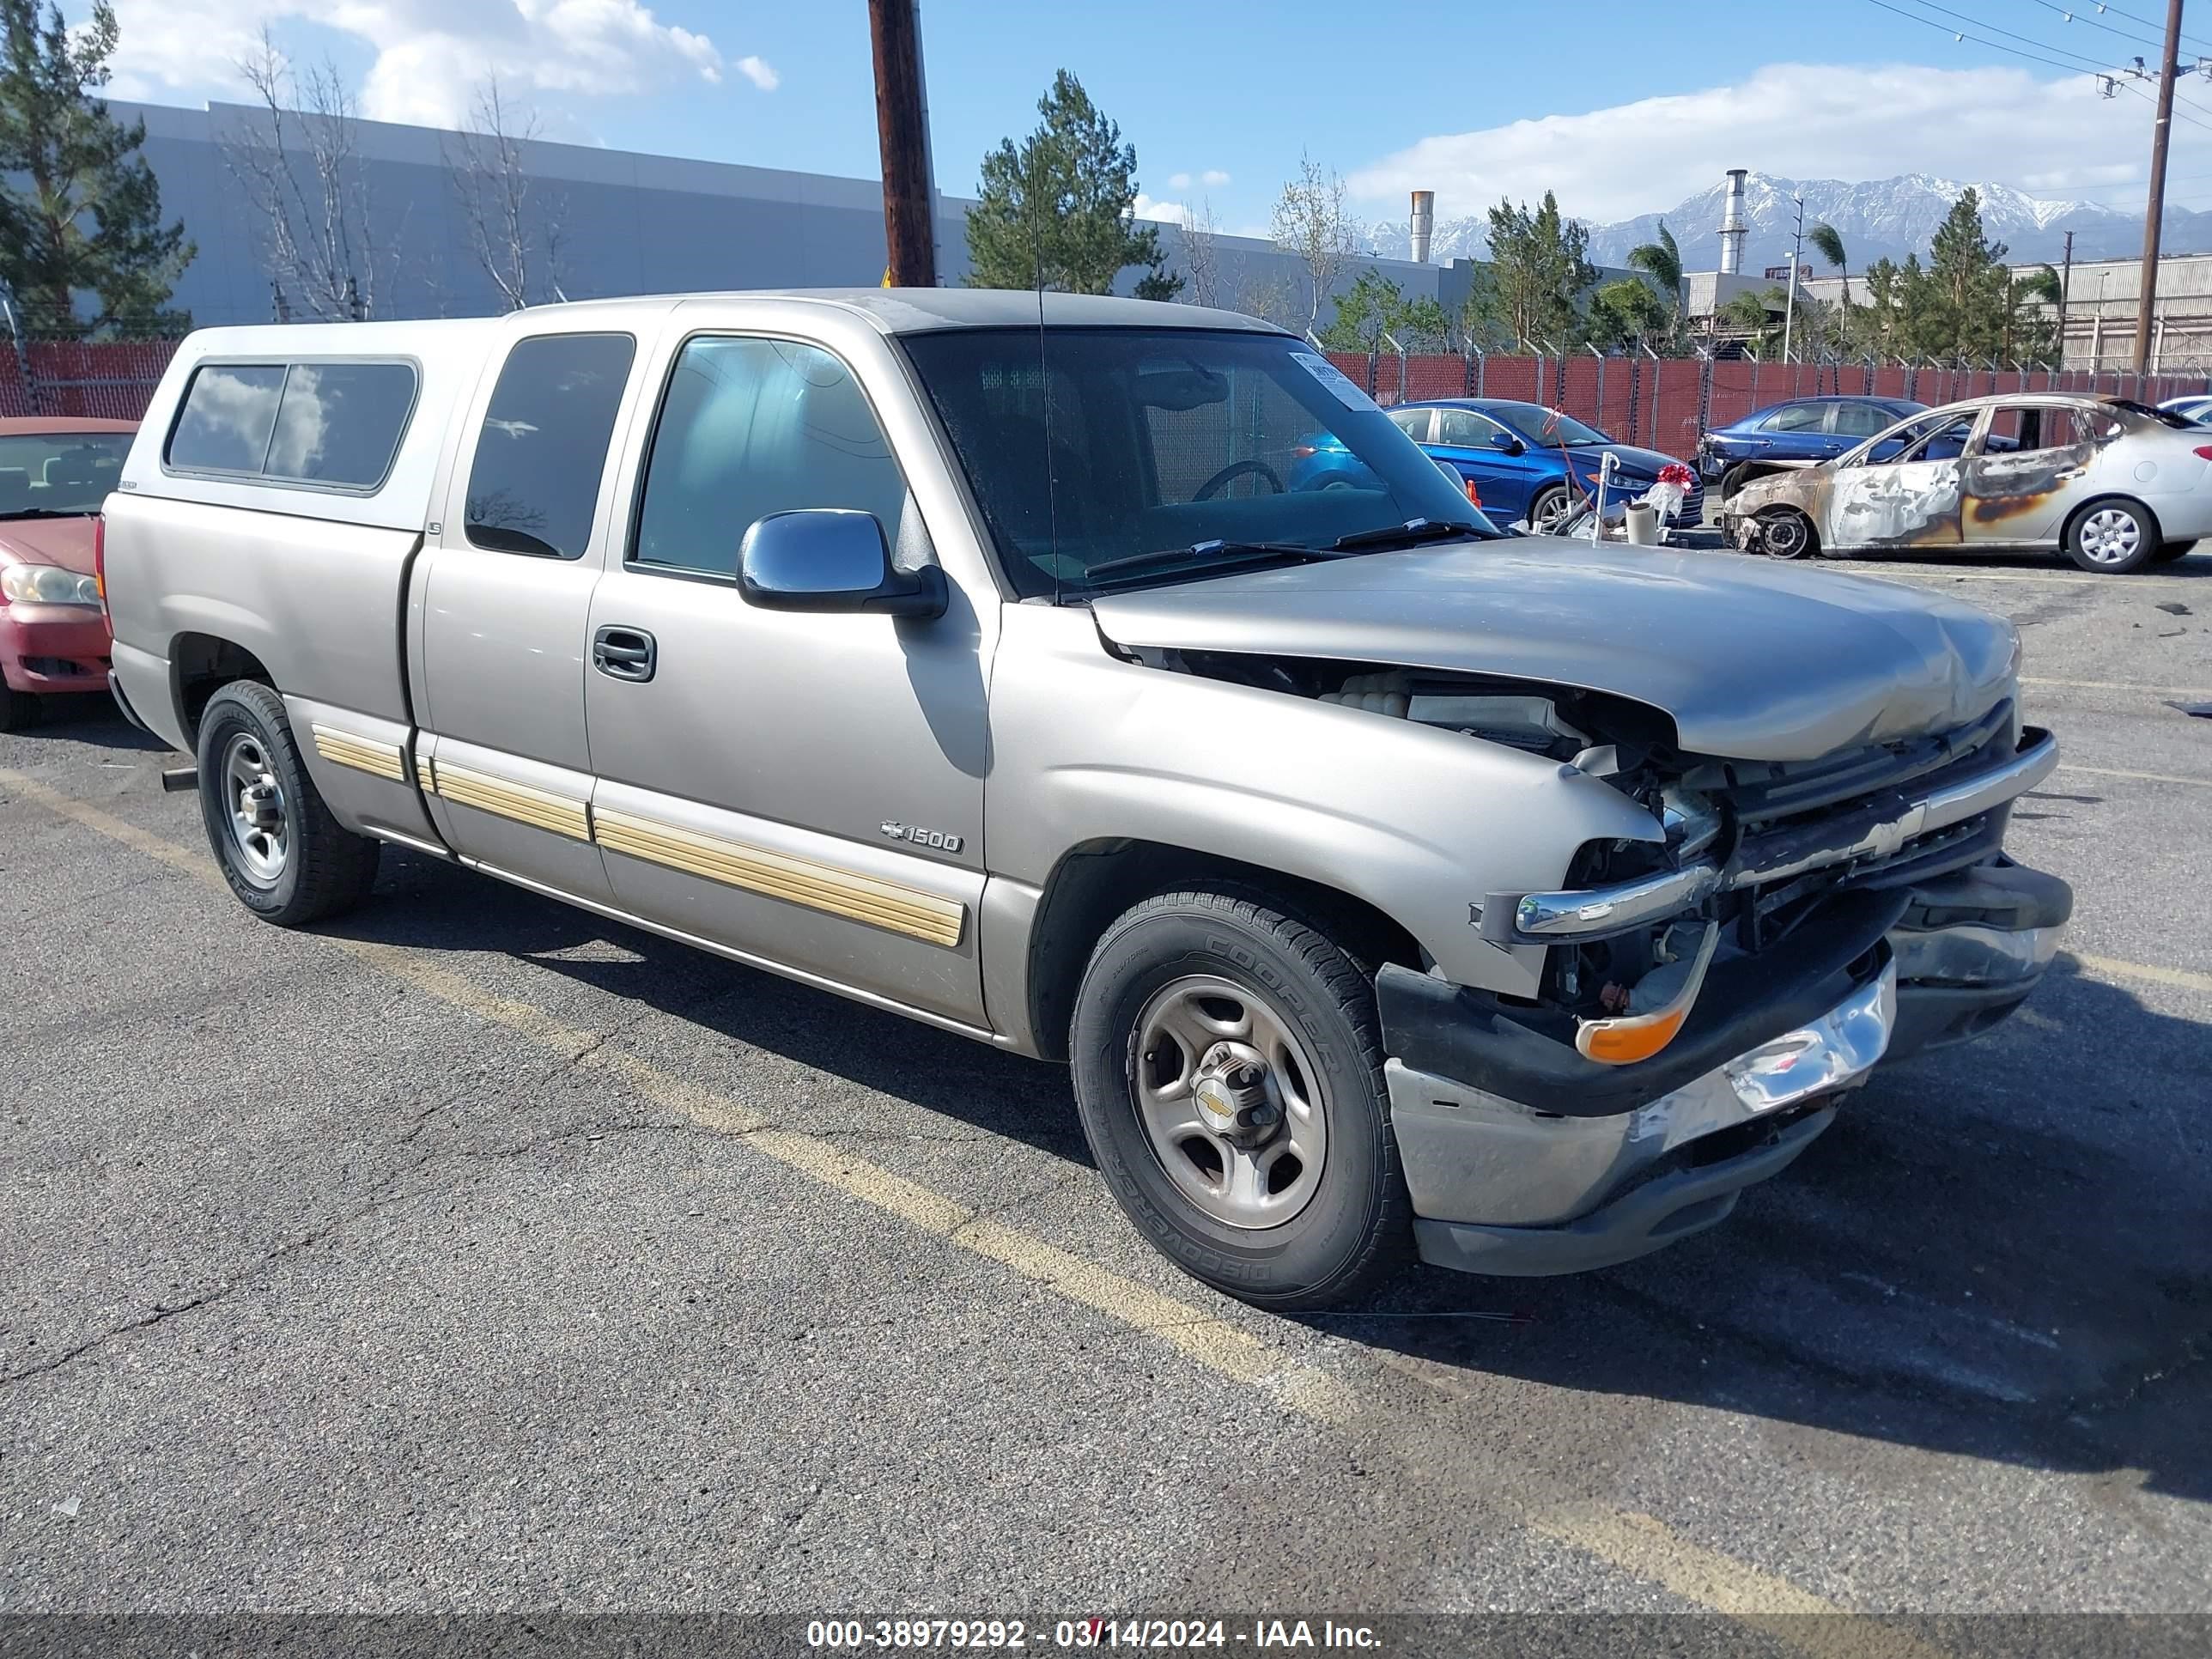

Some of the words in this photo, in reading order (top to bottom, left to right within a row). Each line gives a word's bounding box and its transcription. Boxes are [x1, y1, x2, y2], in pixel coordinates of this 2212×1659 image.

[907, 826, 960, 852] 1500
[1203, 933, 1342, 1079] COOPER
[1103, 1156, 1271, 1281] DISCOVERER
